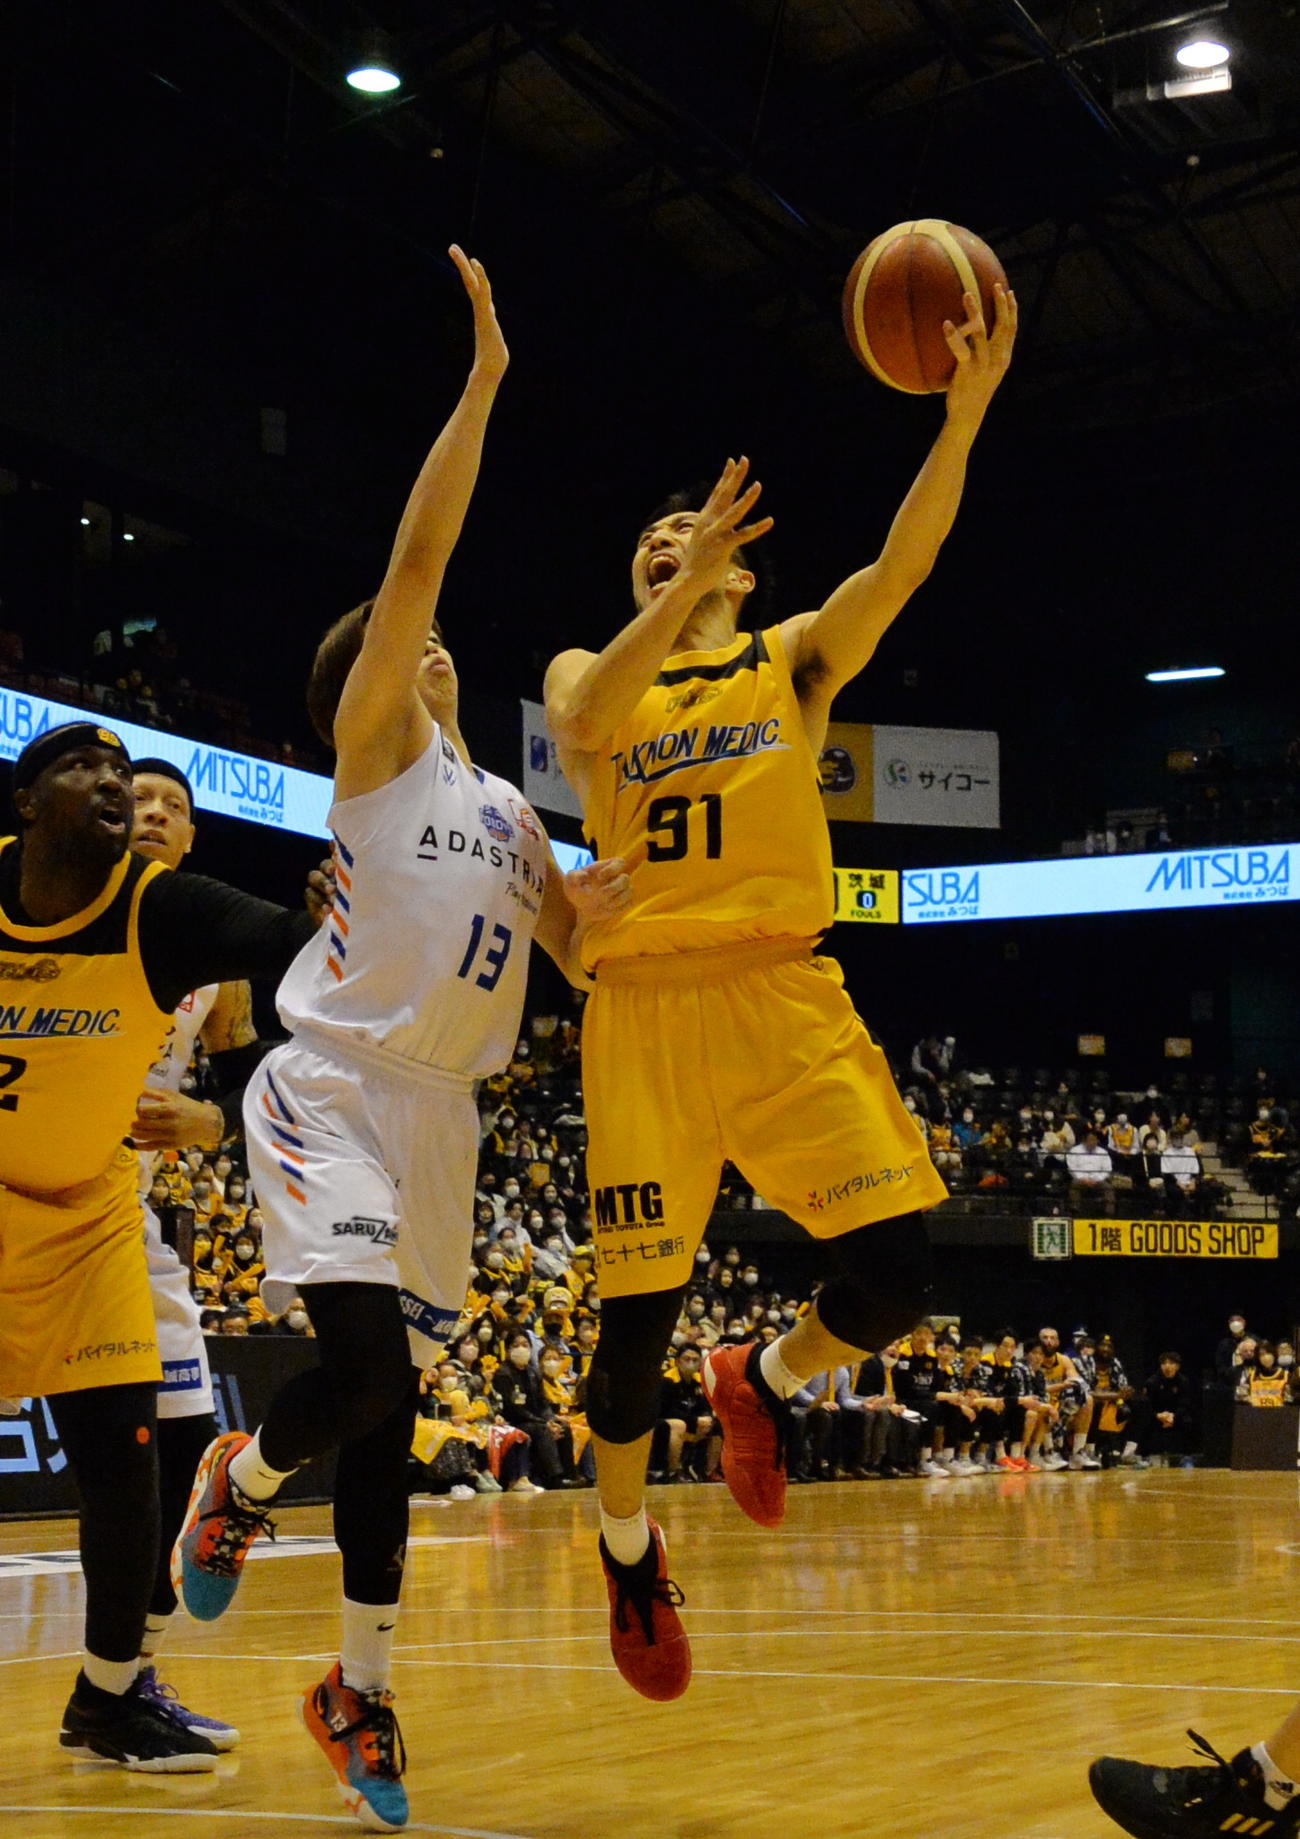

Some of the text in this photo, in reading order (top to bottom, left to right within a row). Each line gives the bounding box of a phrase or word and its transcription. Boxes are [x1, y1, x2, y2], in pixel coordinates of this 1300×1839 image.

[703, 718, 779, 757] MEDIC
[186, 748, 284, 809] MITSUBA
[918, 771, 990, 791] サイコー
[646, 793, 722, 862] 91
[419, 825, 544, 898] ADASTRIA
[1145, 850, 1289, 892] MITSUBA
[862, 892, 873, 909] 0
[457, 914, 512, 992] 13
[28, 1007, 120, 1034] MEDIC
[595, 1181, 664, 1227] MTG
[826, 1165, 913, 1204] バイタルネット
[601, 1236, 684, 1264] 七十七銀行
[1088, 1223, 1265, 1256] 1階 GOODS SHOP
